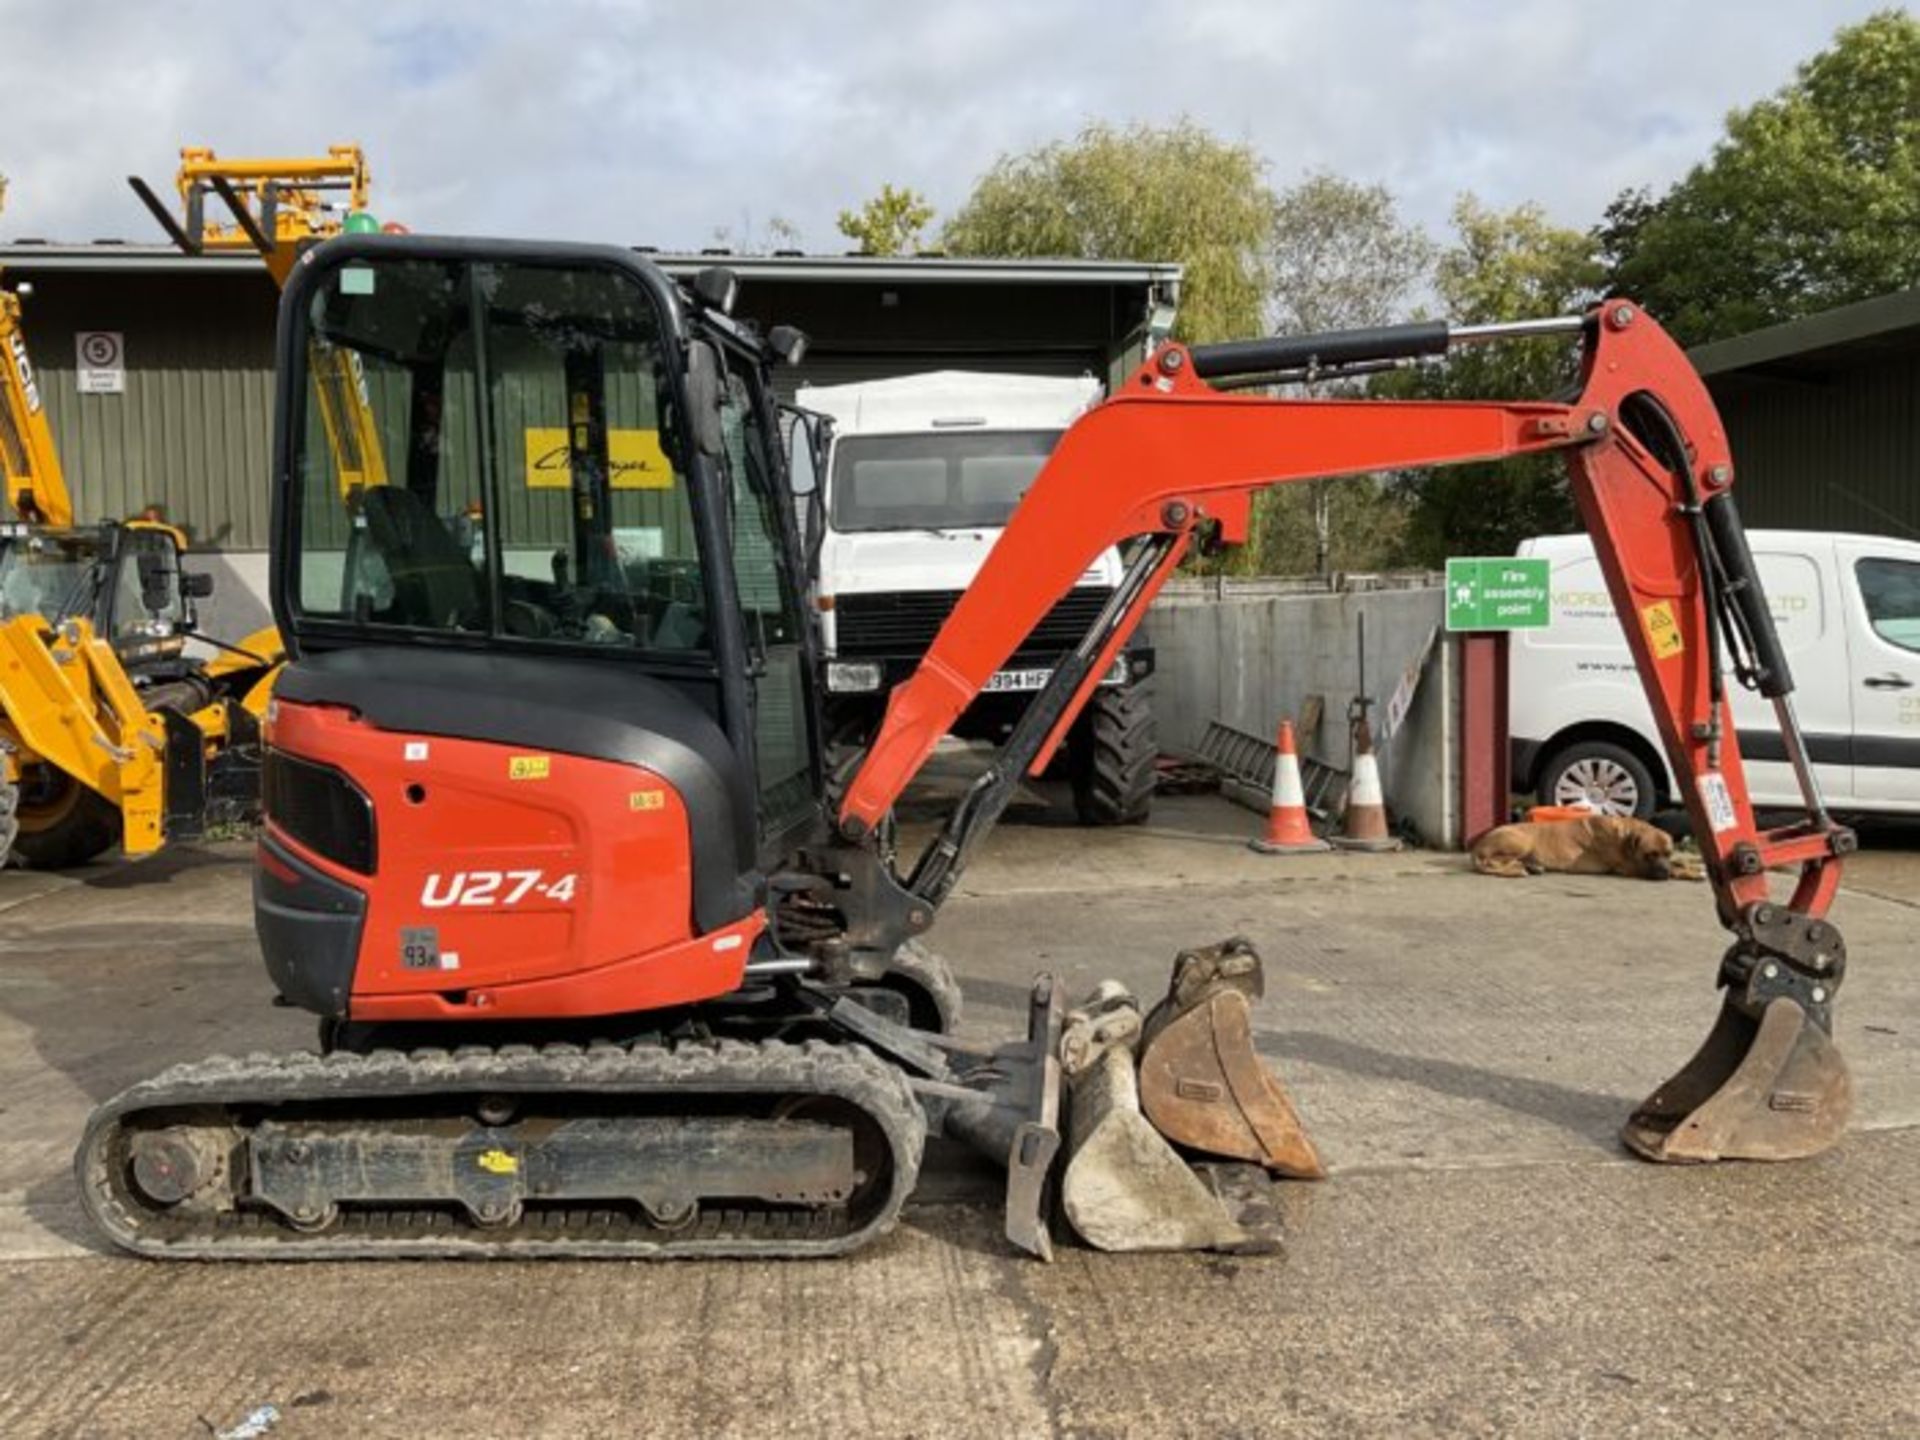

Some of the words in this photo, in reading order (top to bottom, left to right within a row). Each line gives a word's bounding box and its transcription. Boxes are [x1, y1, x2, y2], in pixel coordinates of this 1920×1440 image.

[93, 341, 107, 359] 5
[1502, 571, 1526, 583] Fire
[1483, 587, 1545, 602] assembly
[1497, 604, 1532, 618] point
[420, 869, 578, 908] U27-4
